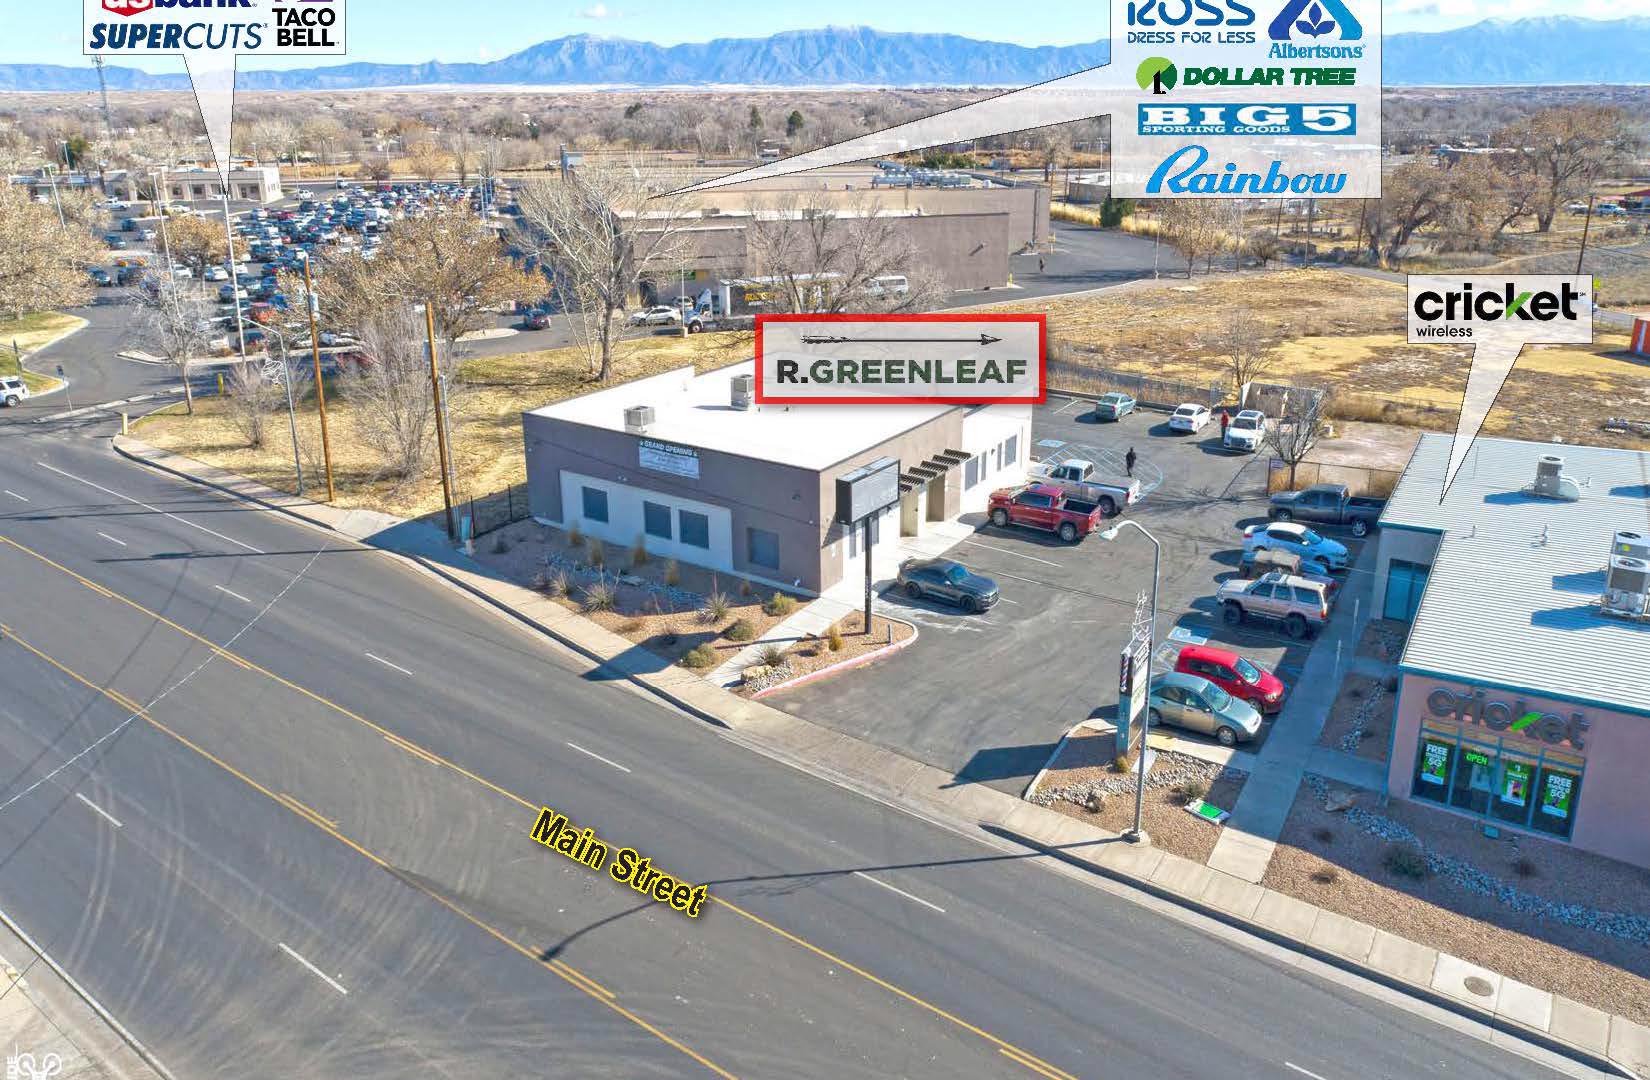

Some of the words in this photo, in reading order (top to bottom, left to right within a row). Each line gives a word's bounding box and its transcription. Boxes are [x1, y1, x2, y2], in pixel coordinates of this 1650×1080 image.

[644, 440, 665, 450] GRAND
[665, 445, 693, 456] OPENING
[1427, 687, 1592, 751] cricket
[1426, 744, 1449, 757] FREE
[1466, 752, 1489, 766] OPEN
[1548, 774, 1573, 788] FREE
